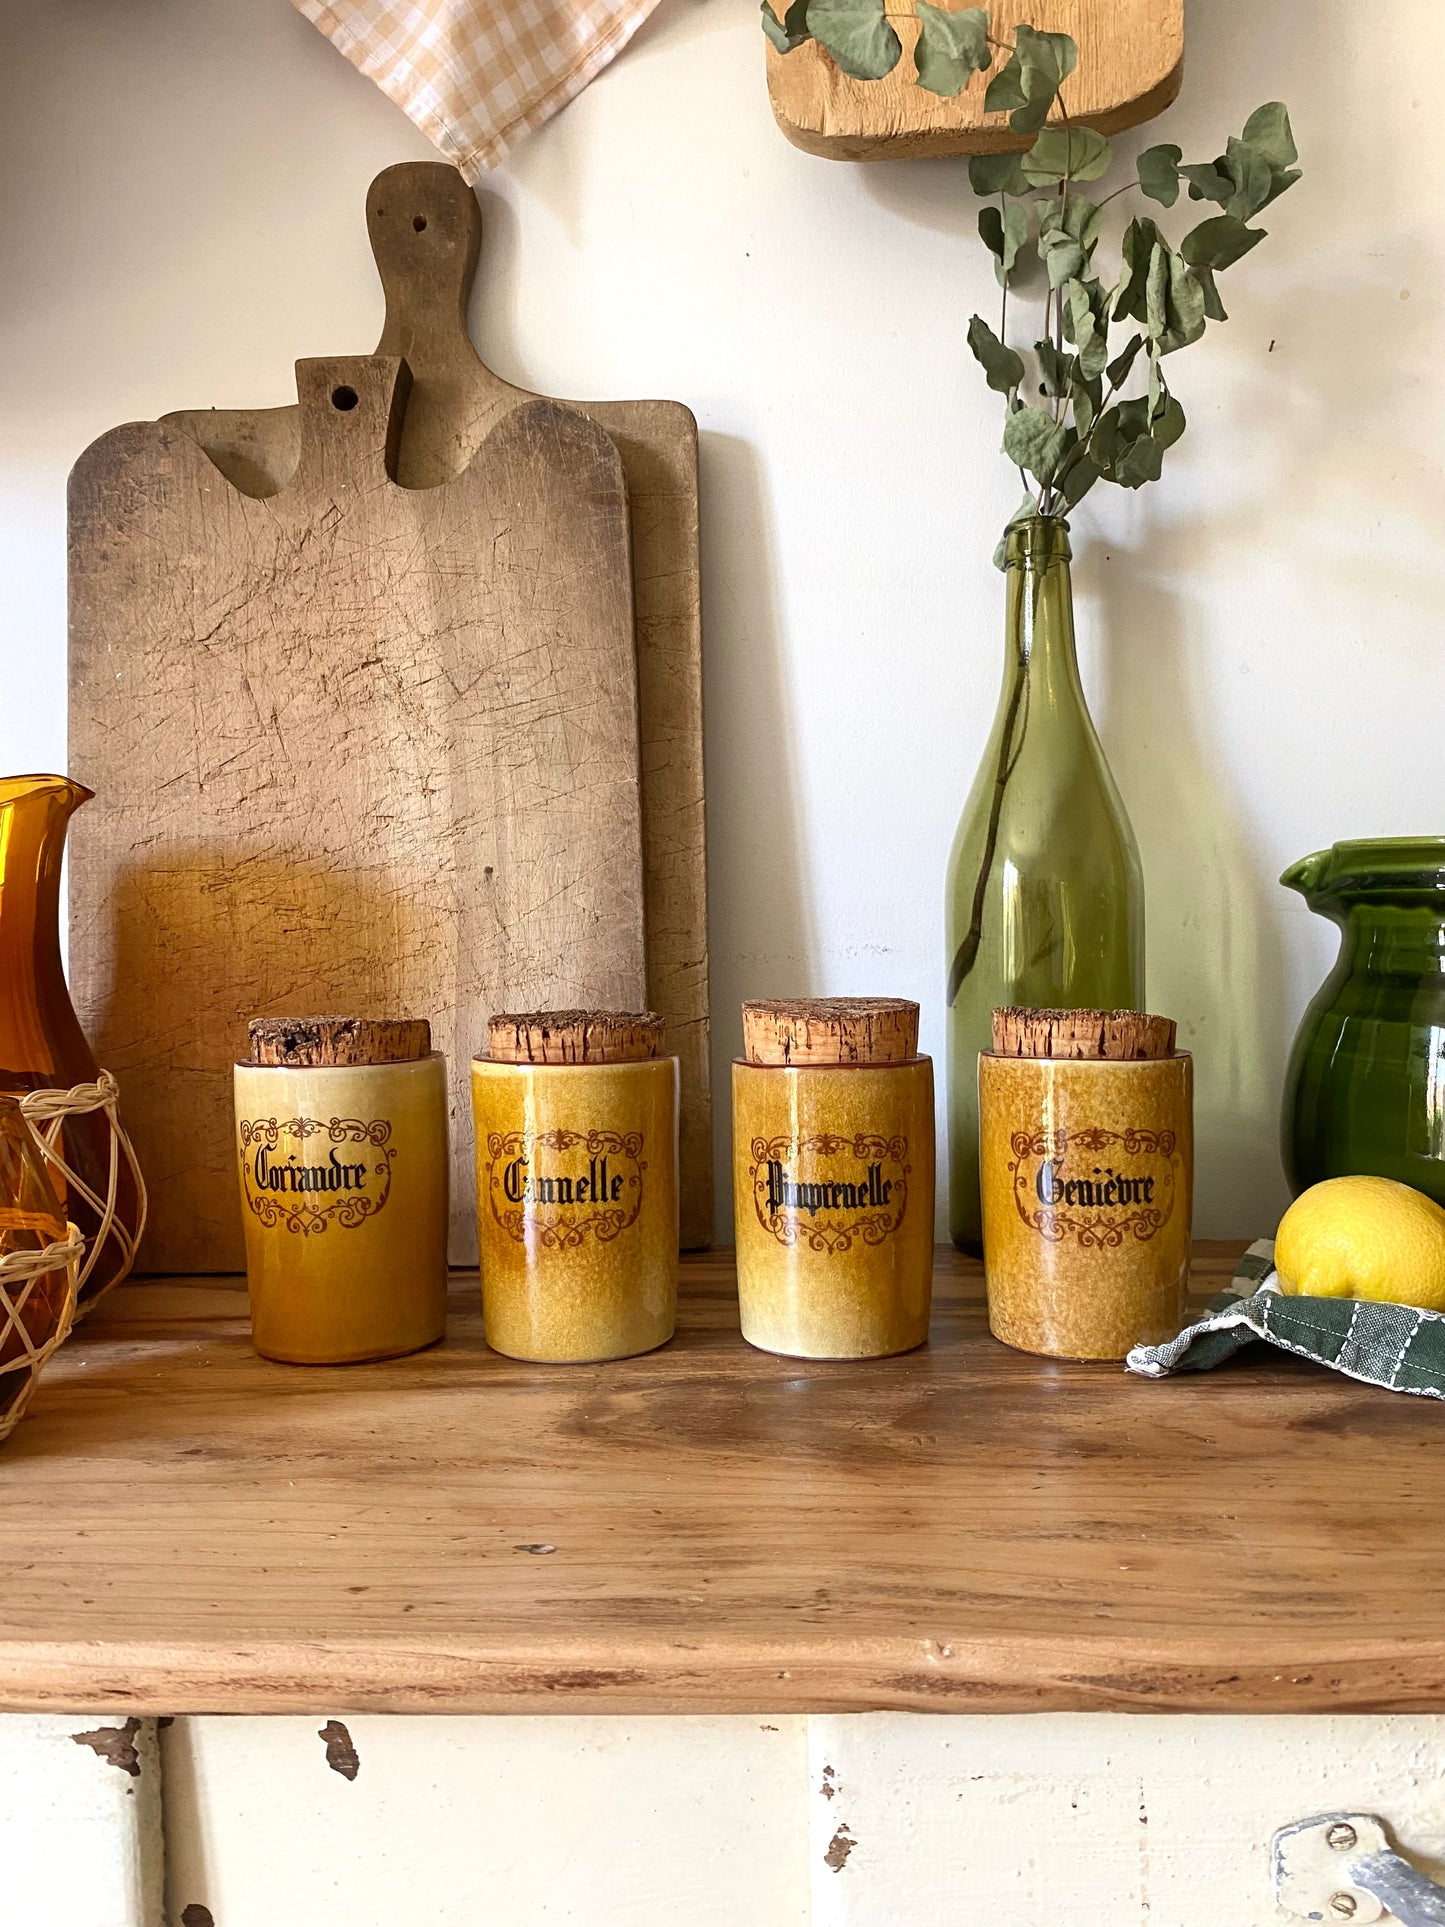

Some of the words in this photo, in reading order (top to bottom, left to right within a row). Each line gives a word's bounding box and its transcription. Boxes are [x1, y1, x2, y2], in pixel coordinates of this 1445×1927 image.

[255, 1144, 366, 1192] Coriandre
[766, 1160, 893, 1216] Pimprenelle
[1036, 1158, 1155, 1207] Genièvre
